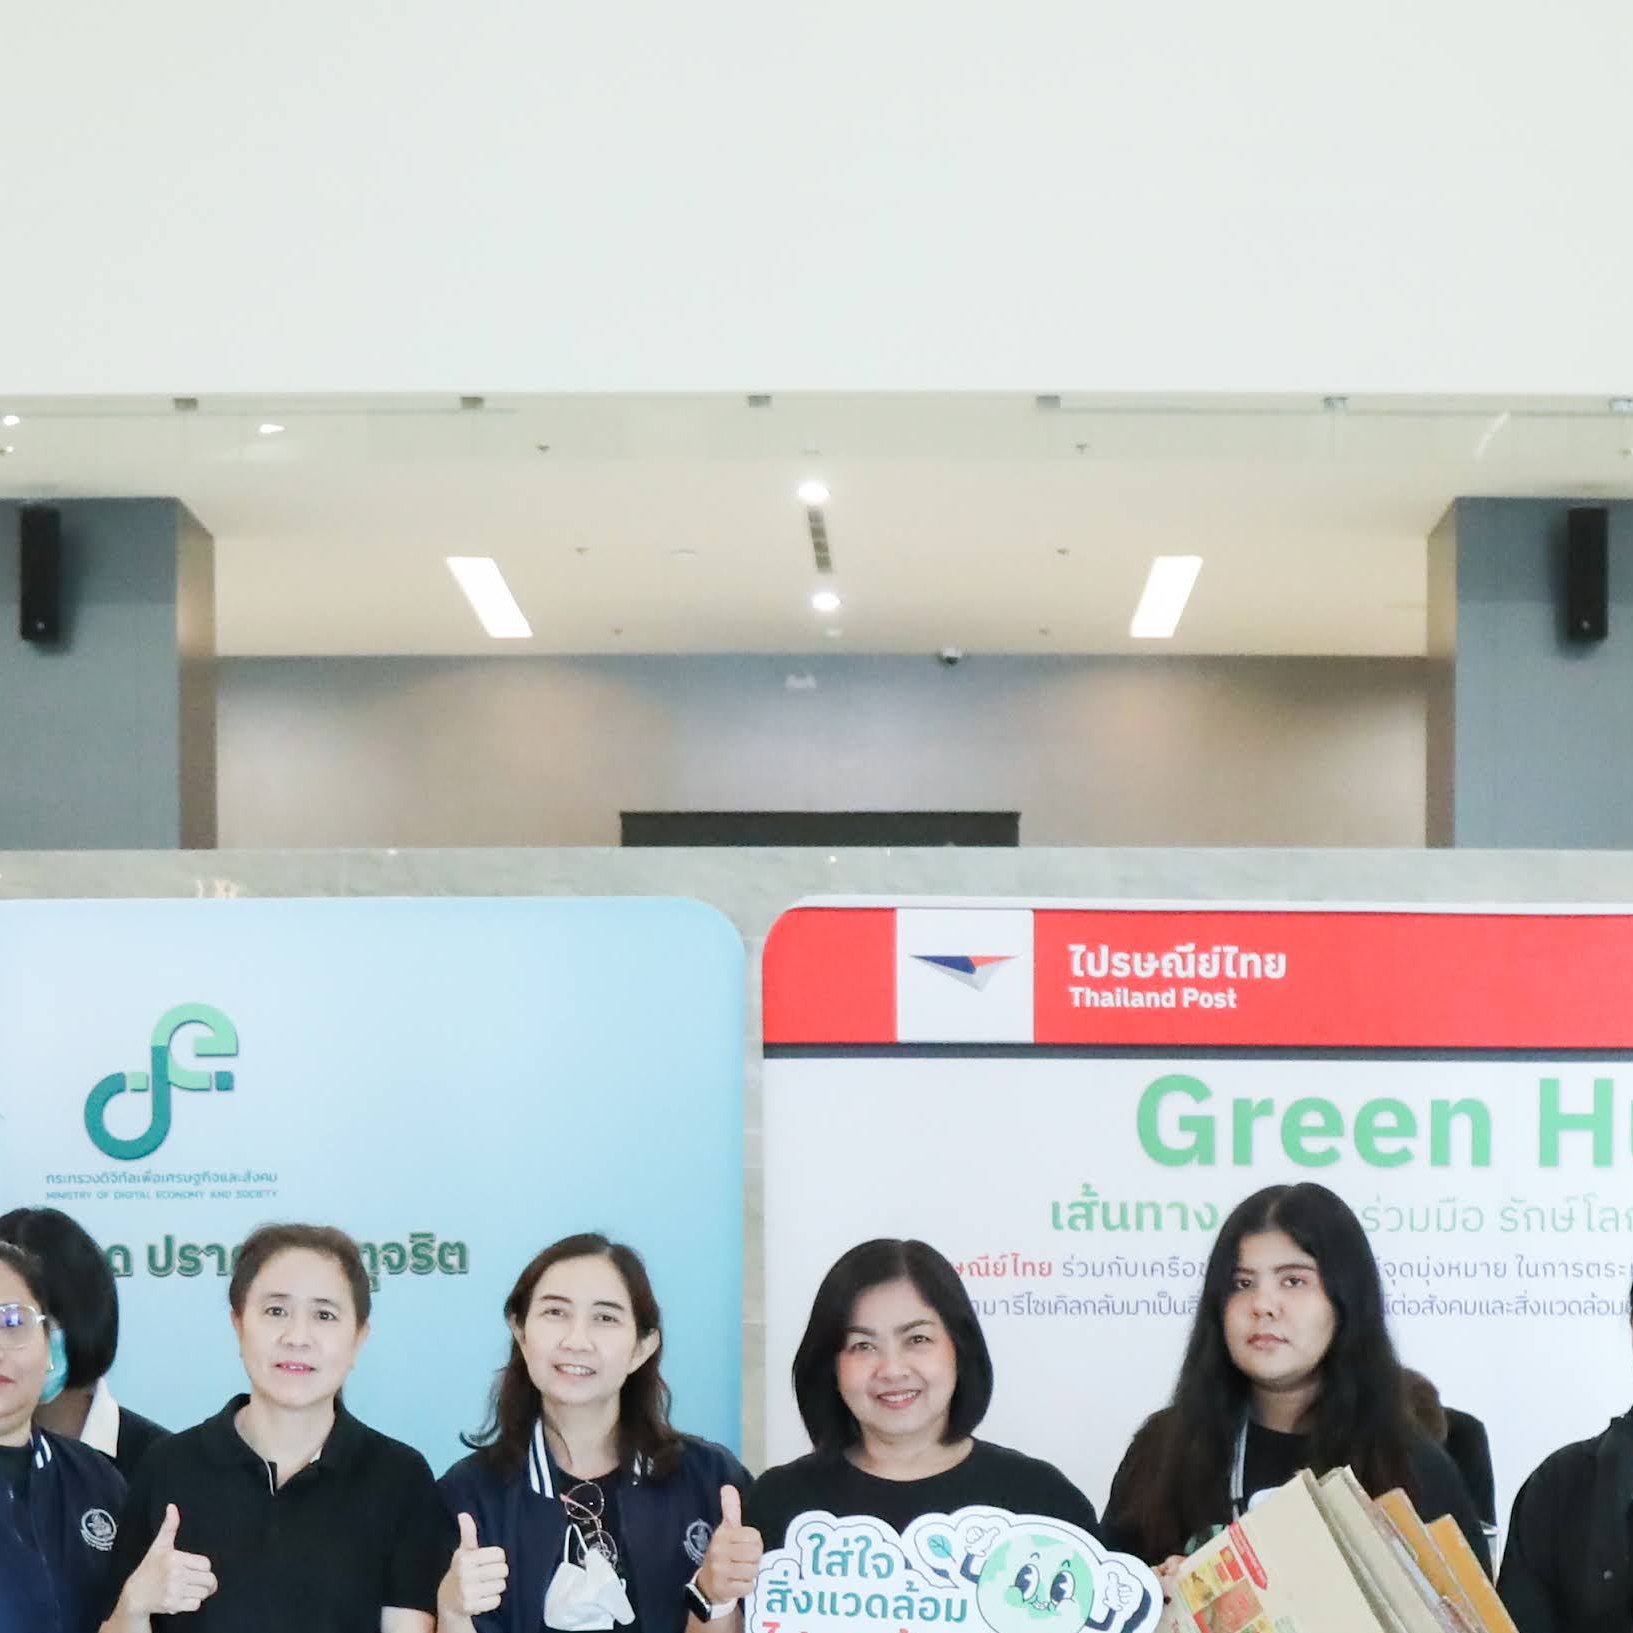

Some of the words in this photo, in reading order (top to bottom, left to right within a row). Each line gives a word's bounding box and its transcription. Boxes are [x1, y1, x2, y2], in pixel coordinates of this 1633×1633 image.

[1068, 942, 1287, 980] ไปรษณีย์ไทย
[1068, 986, 1177, 1008] Thailand
[1182, 987, 1238, 1009] Post
[1136, 1073, 1492, 1169] Green
[46, 1189, 92, 1200] MINISTRY
[96, 1189, 111, 1200] OF
[113, 1189, 150, 1200] DIGITAL
[155, 1189, 204, 1200] ECONOMY
[209, 1189, 232, 1200] AND
[235, 1189, 278, 1200] SOCIETY
[1363, 1192, 1484, 1234] ร่วมมือ
[806, 1531, 895, 1581] ใส่ใจ
[764, 1568, 968, 1625] สิ่งแวดล้อม
